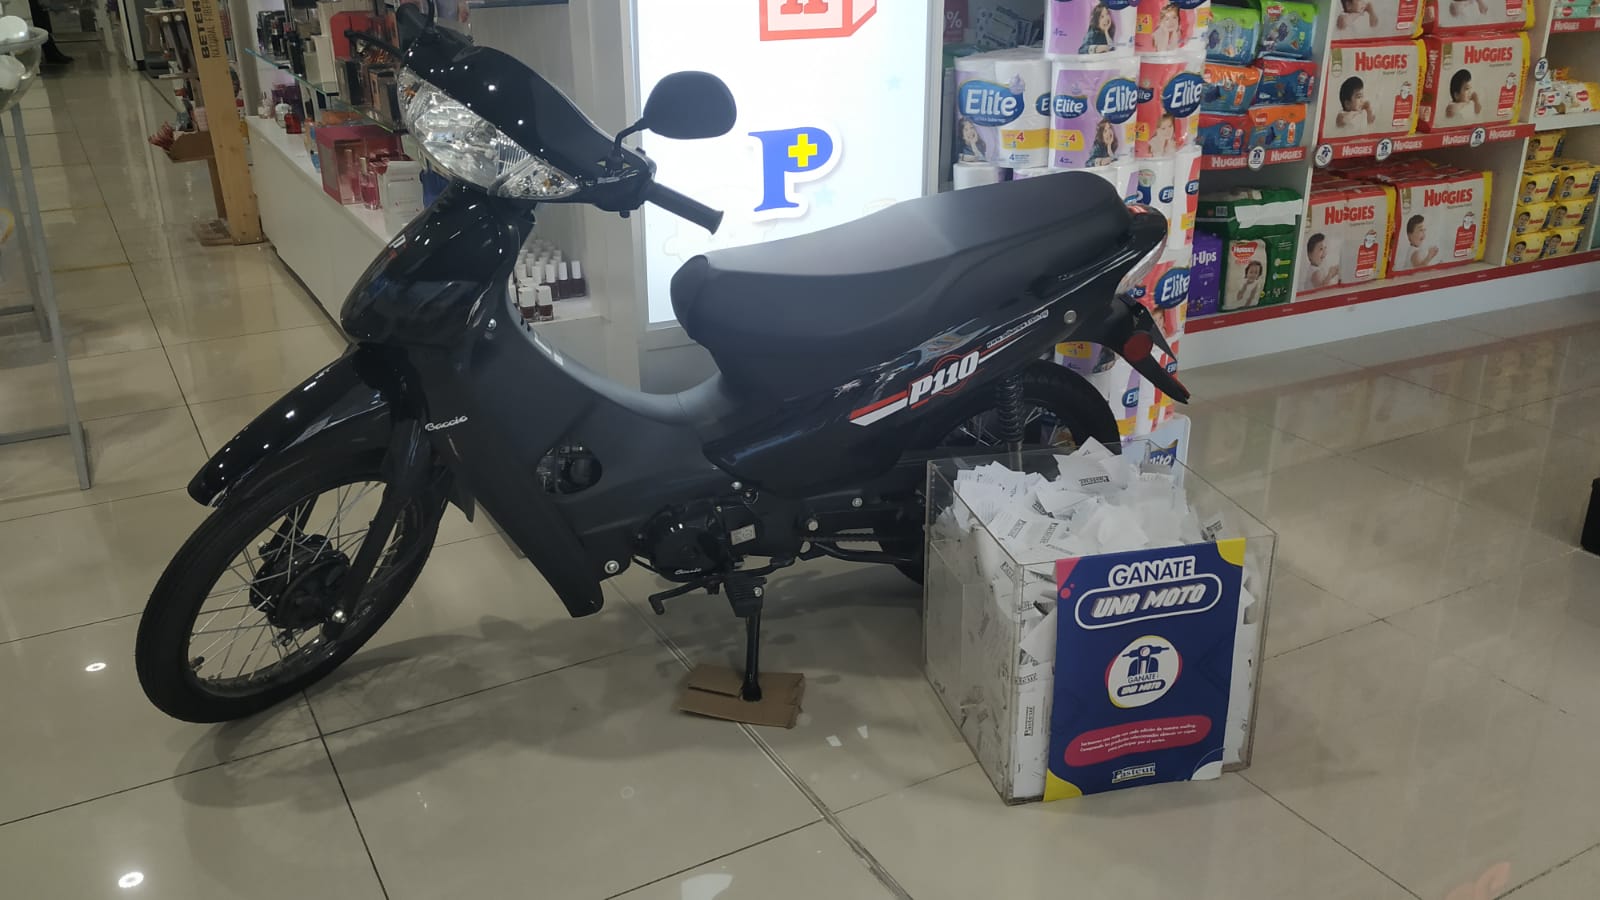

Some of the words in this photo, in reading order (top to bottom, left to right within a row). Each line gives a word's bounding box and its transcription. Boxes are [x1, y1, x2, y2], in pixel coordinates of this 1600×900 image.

[1355, 52, 1407, 71] HUGGIES
[1464, 46, 1512, 64] HUGGIES
[965, 89, 1017, 116] Elite
[1104, 86, 1137, 113] Elite
[1171, 81, 1202, 108] Elite
[1055, 99, 1083, 112] Elite
[1212, 157, 1247, 168] HUGGIE
[1270, 150, 1303, 162] HUGGIES
[1424, 188, 1472, 207] HUGGIES
[1325, 206, 1374, 225] HUGGIES
[1161, 273, 1190, 302] Elite
[909, 351, 980, 405] P110
[424, 415, 468, 432] Baccio
[1112, 558, 1193, 586] GANATE
[1091, 592, 1140, 618] UNA
[1142, 583, 1207, 610] MOTO
[1127, 673, 1157, 683] GANATE
